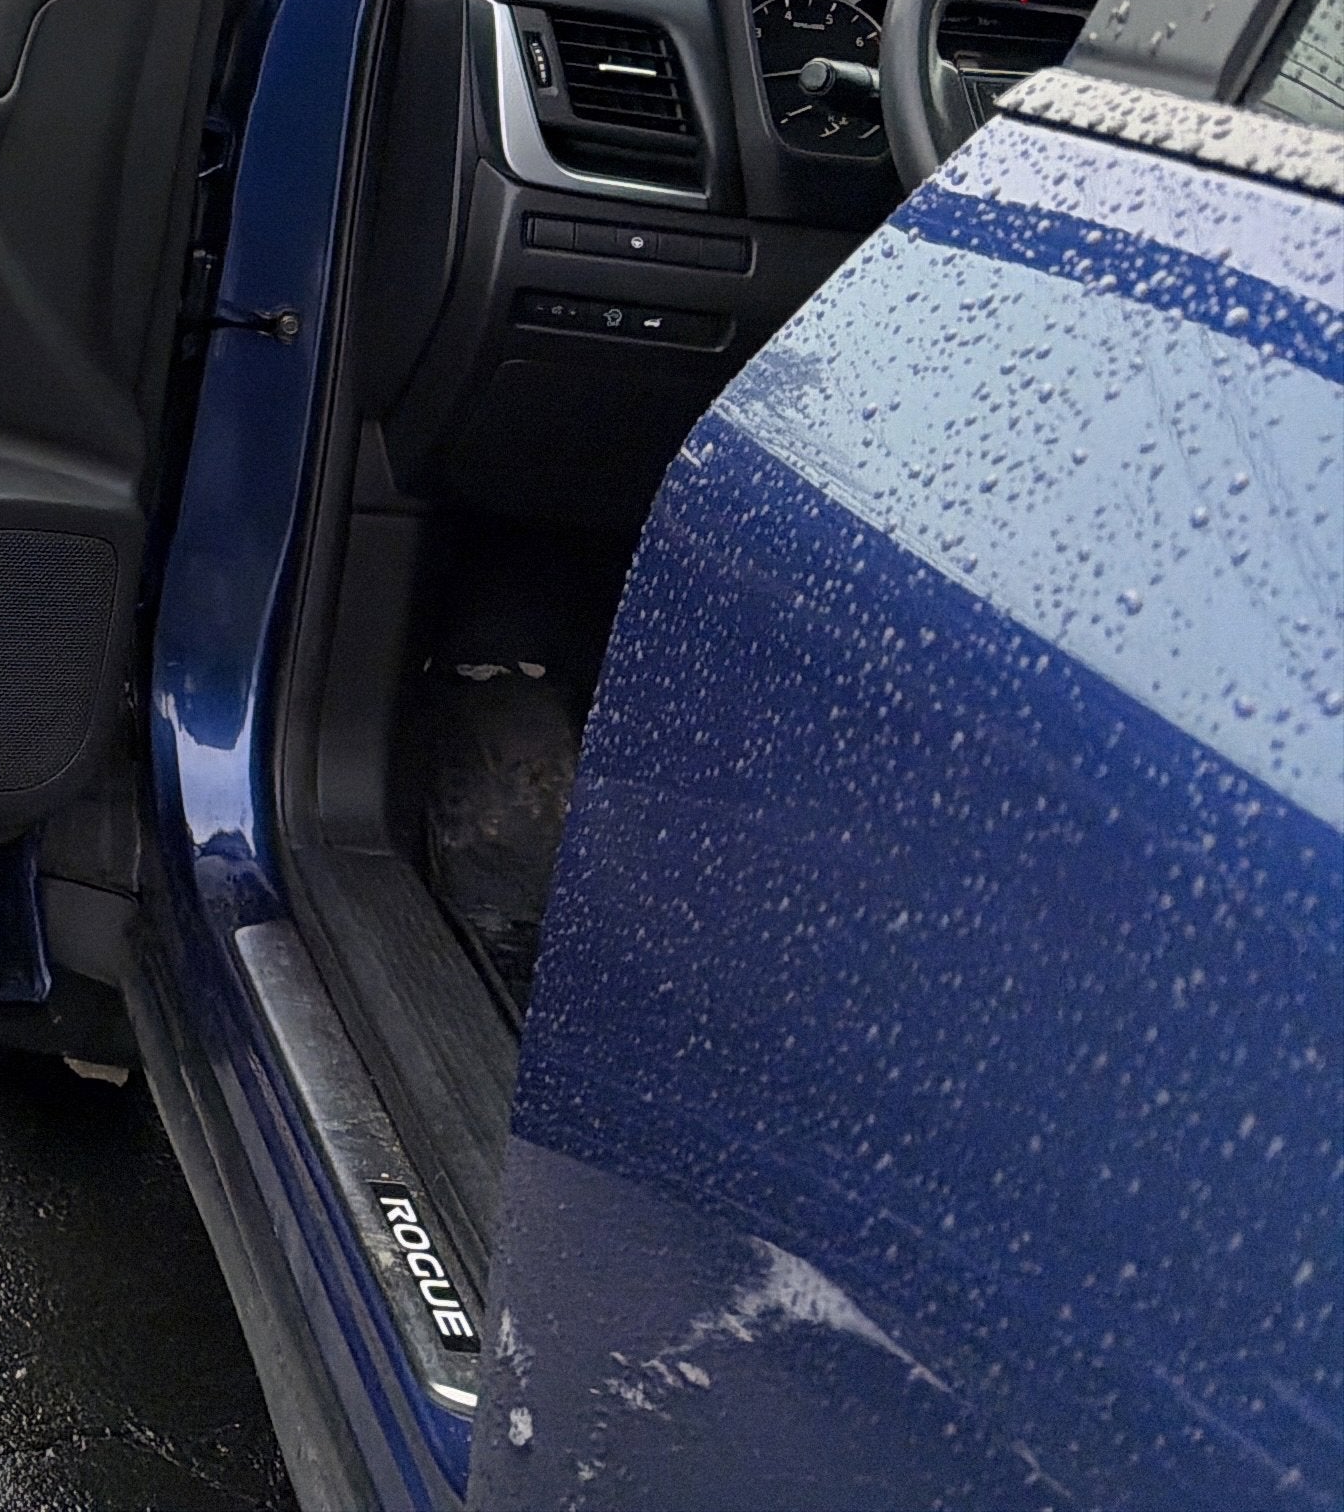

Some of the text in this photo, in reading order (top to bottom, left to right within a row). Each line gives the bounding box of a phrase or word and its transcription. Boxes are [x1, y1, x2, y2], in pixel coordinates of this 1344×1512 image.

[784, 11, 792, 20] 4
[826, 14, 833, 24] 5
[856, 37, 864, 47] 6
[379, 1197, 474, 1338] ROGUE
